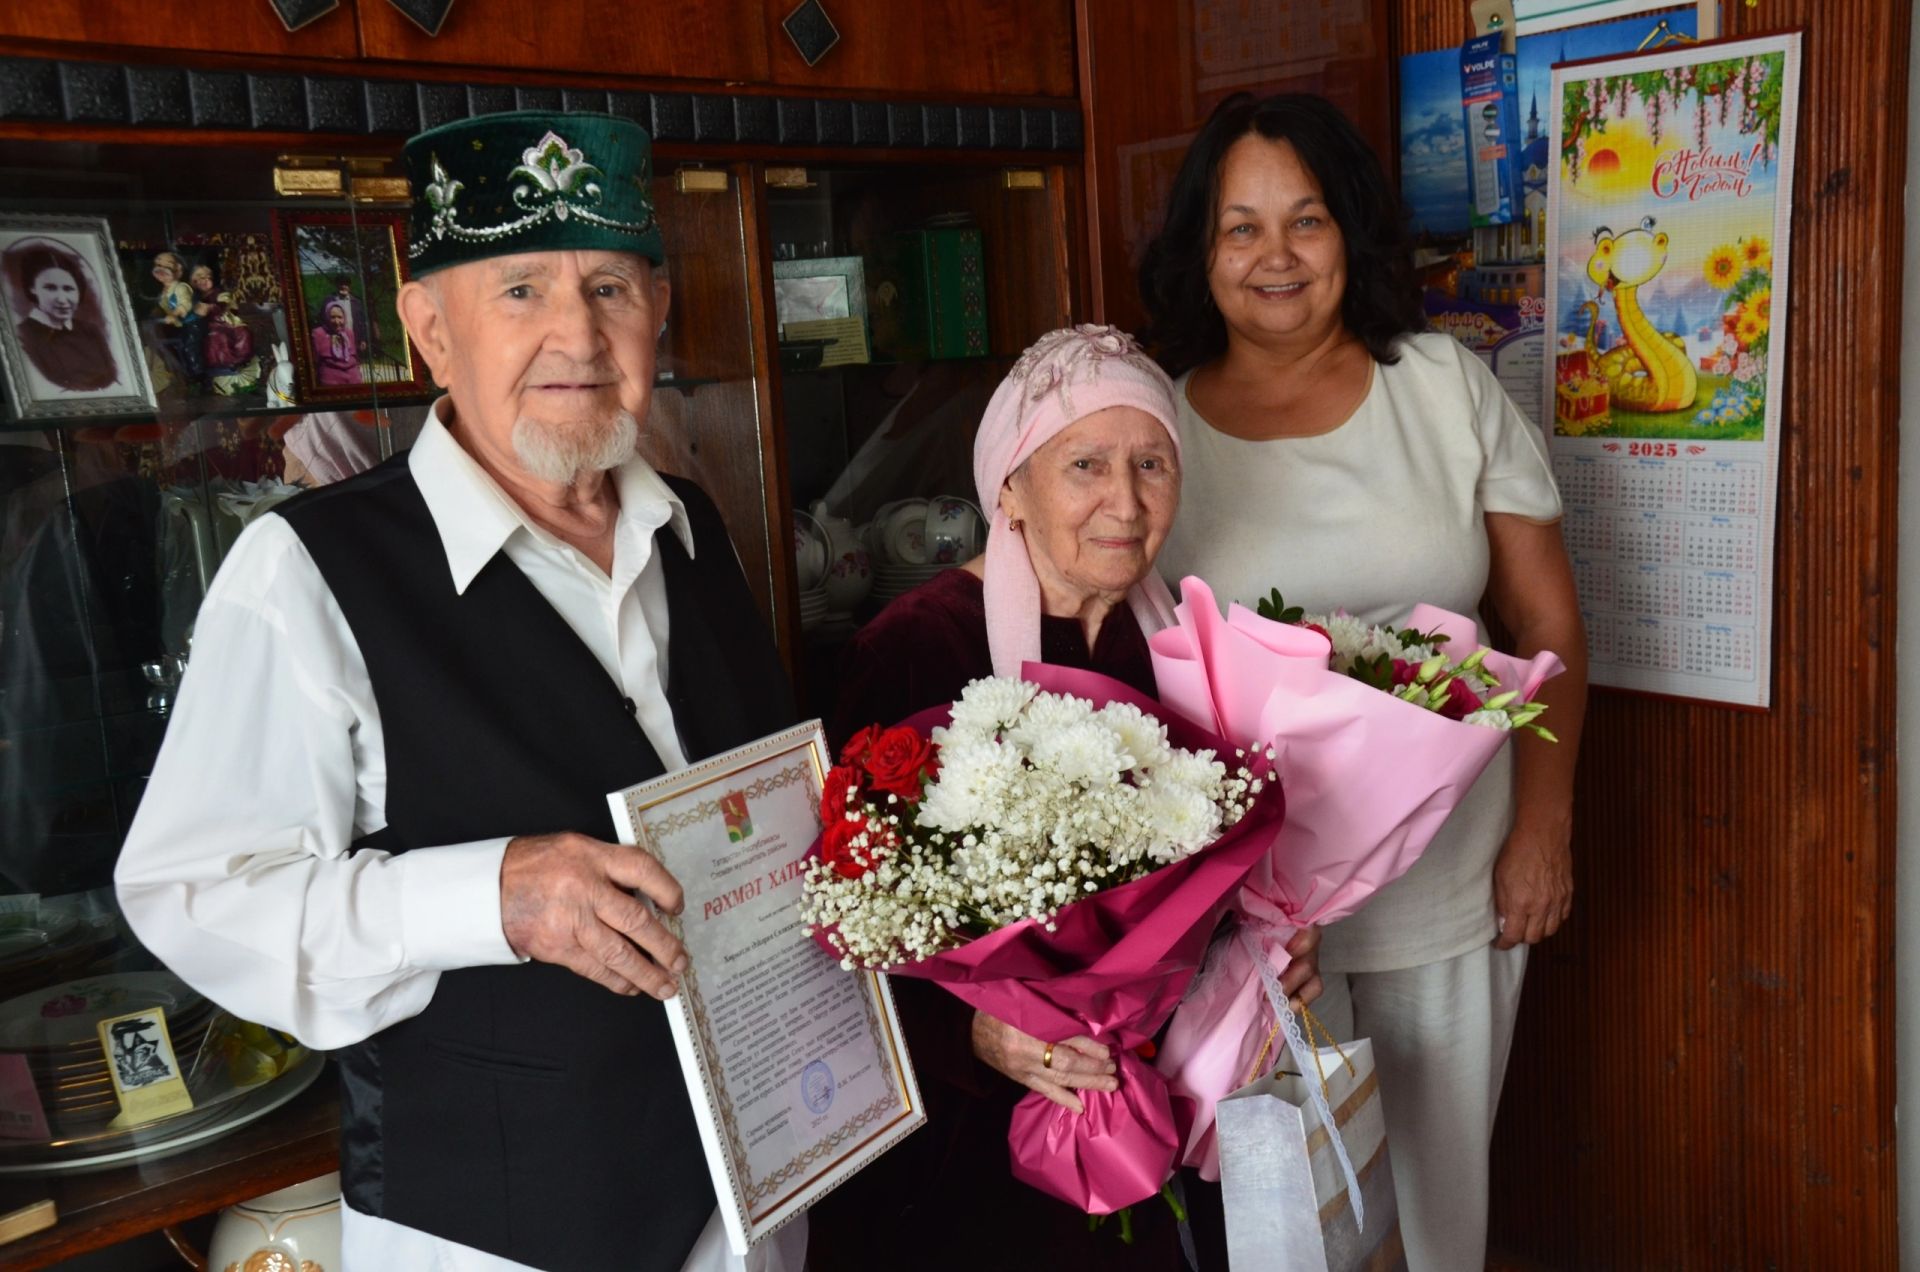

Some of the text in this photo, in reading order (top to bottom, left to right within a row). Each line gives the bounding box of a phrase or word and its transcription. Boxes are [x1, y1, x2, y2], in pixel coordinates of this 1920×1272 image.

[1471, 59, 1495, 72] VOLPE
[1440, 311, 1485, 330] 1446
[1628, 441, 1678, 457] 2025
[703, 877, 763, 921] РӘХМӘТ
